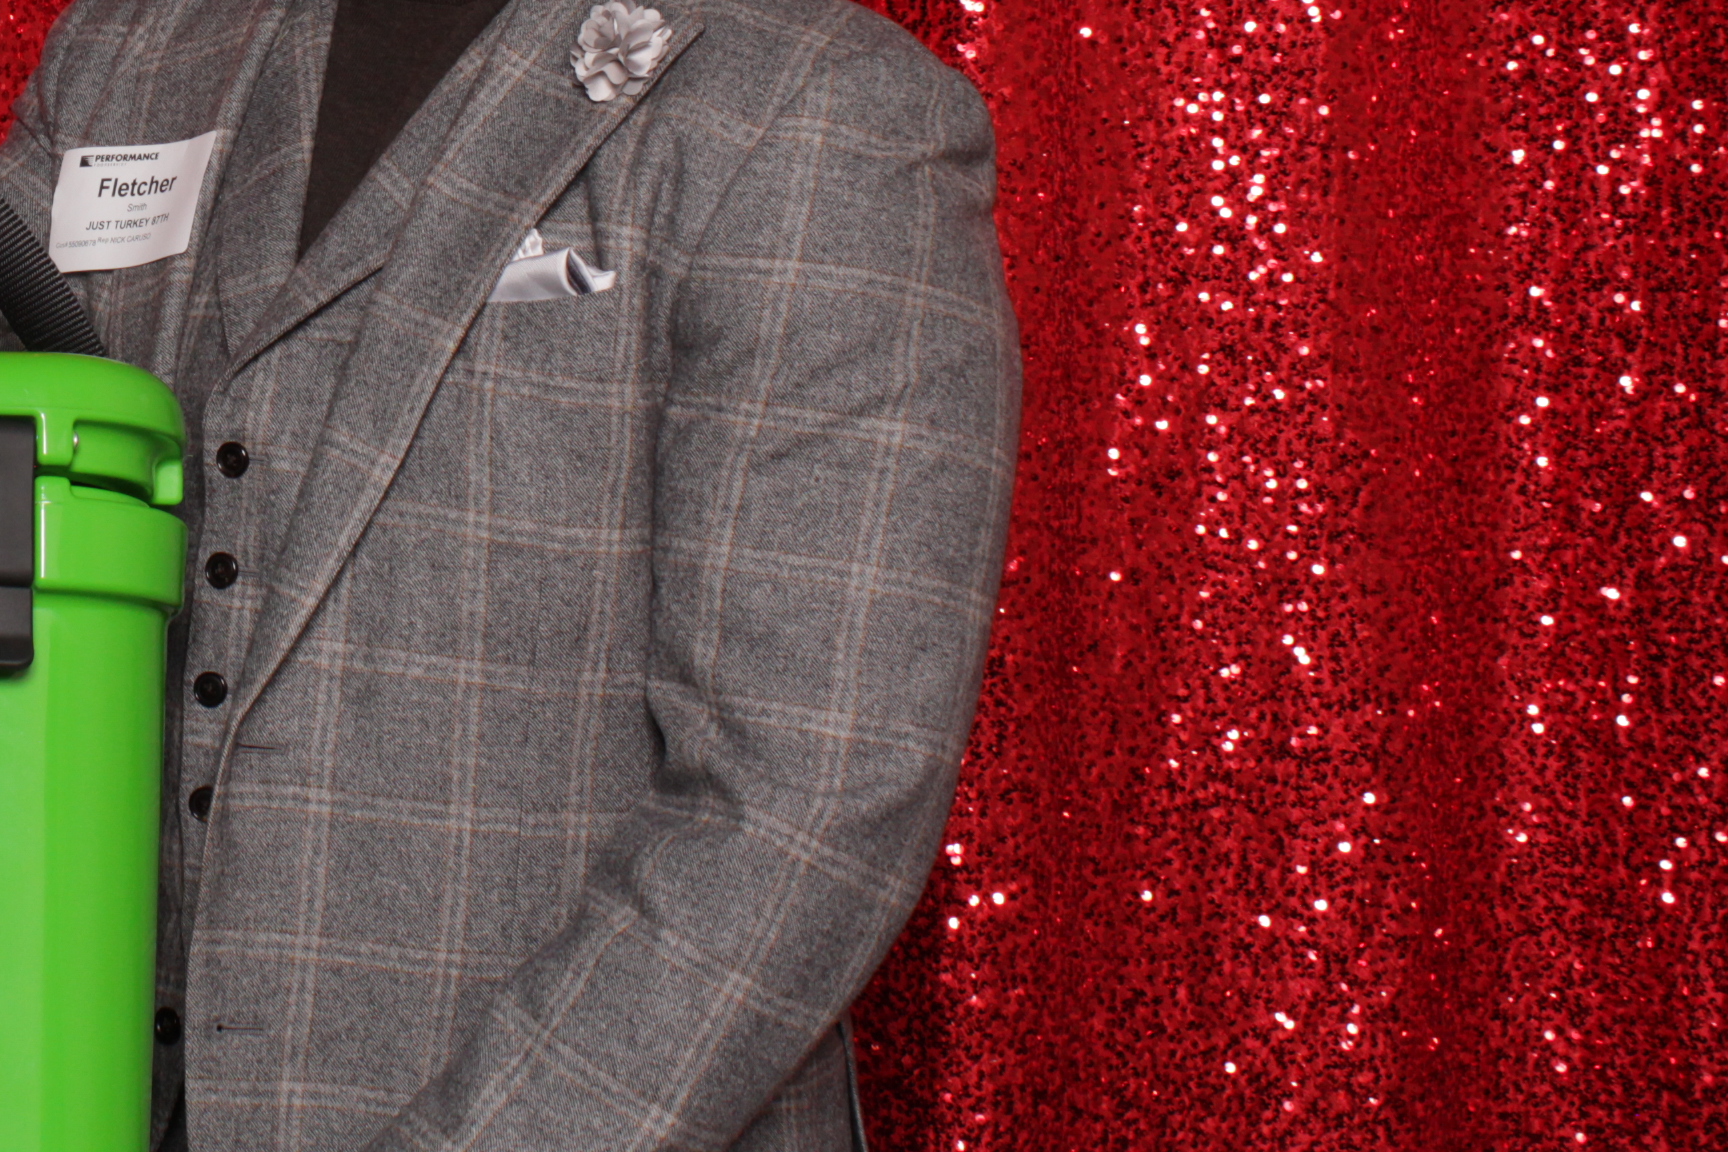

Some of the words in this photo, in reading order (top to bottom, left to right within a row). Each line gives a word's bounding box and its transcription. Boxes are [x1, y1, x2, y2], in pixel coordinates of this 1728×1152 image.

[95, 152, 160, 162] PERFORMANCE
[98, 175, 178, 198] Fletcher
[127, 202, 147, 212] Smith
[85, 220, 112, 231] JUST
[114, 217, 150, 230] TURKEY
[151, 213, 170, 226] 87TH
[110, 236, 126, 244] NICK
